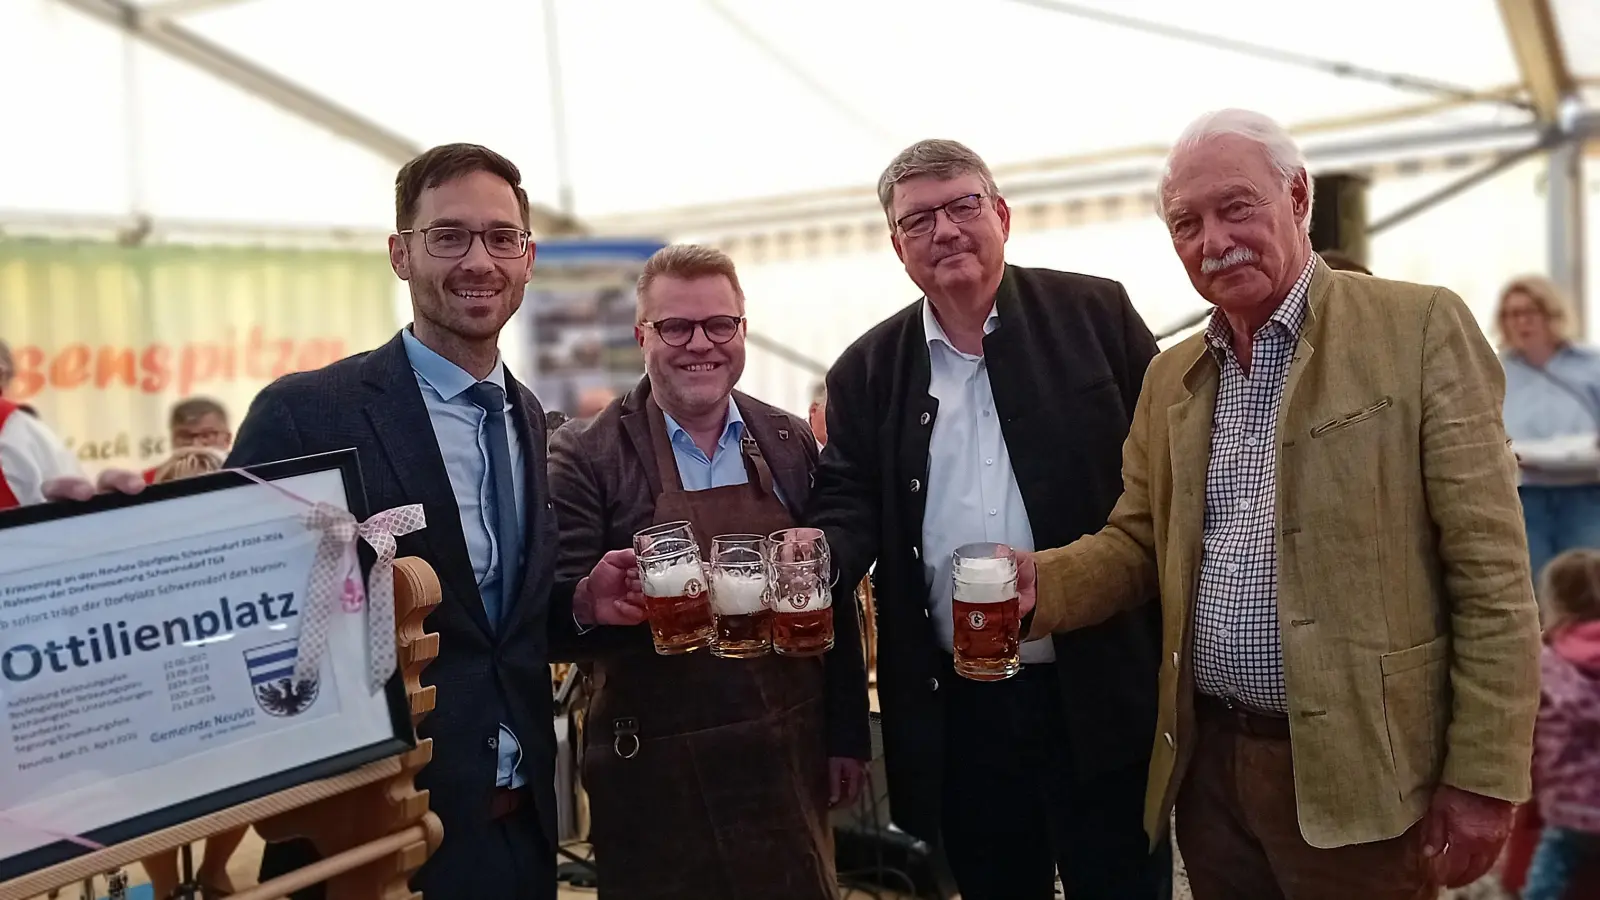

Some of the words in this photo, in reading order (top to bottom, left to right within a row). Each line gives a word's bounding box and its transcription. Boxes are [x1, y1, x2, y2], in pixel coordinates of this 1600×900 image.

[12, 611, 48, 627] sofort
[50, 604, 78, 619] trägt
[82, 600, 100, 613] der
[1, 591, 298, 682] Ottilienplatz
[150, 719, 212, 743] Gemeinde
